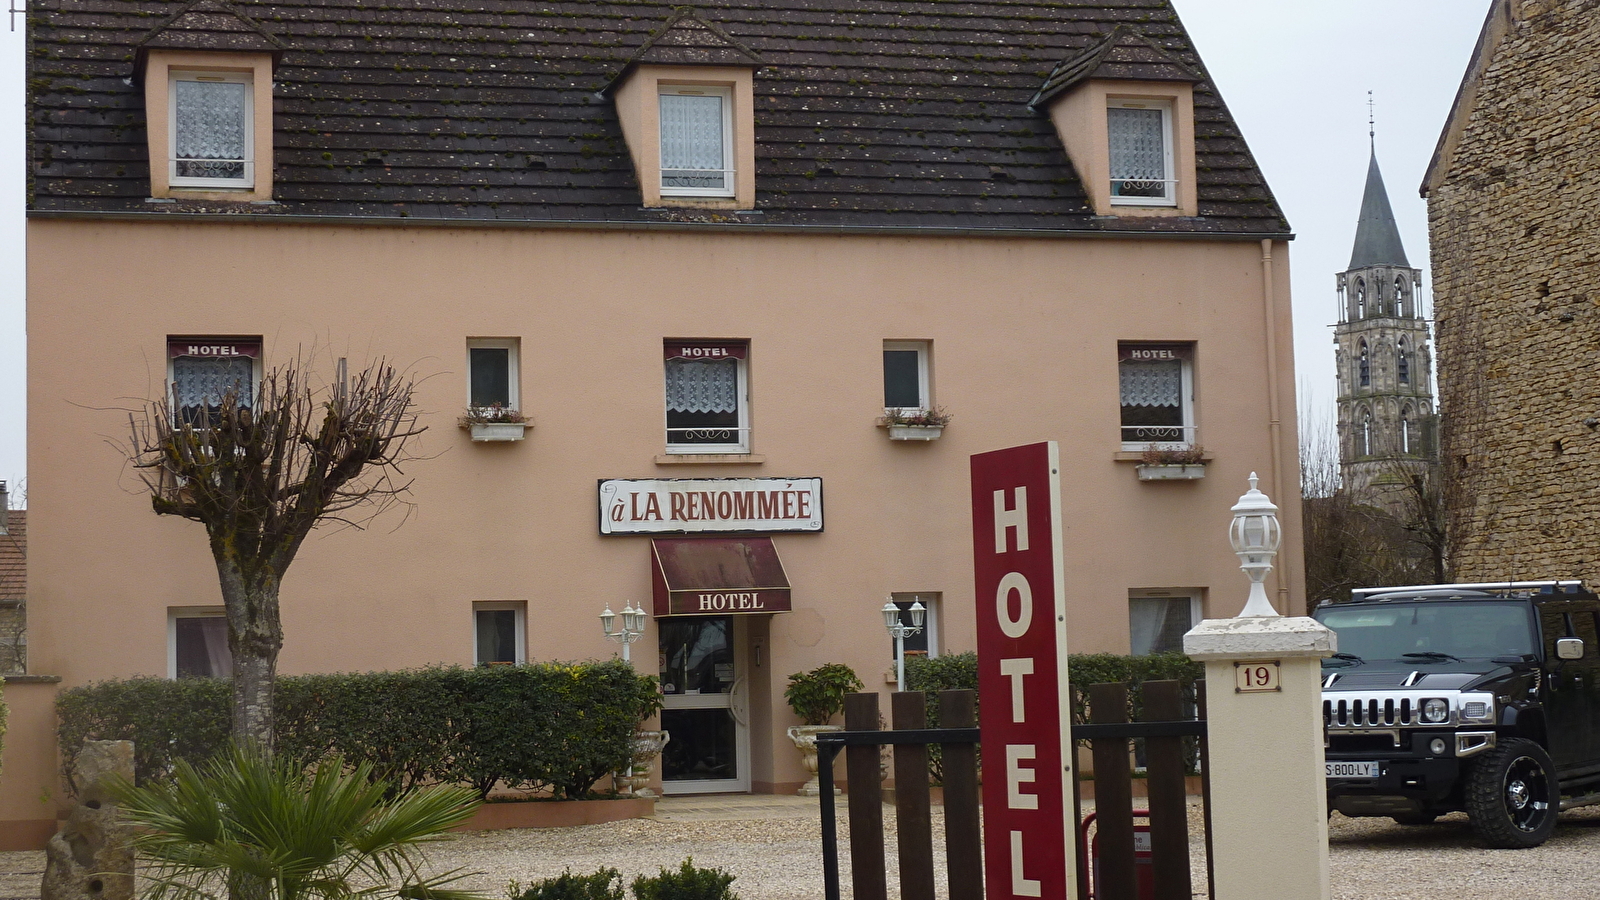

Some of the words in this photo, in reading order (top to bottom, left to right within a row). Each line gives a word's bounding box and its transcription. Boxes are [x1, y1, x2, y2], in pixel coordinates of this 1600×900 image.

[188, 345, 239, 355] HOTEL
[682, 347, 728, 356] HOTEL
[1131, 349, 1175, 358] HOTEL
[611, 498, 625, 522] à
[630, 492, 664, 521] LA
[669, 483, 812, 522] RENOMMÉE
[698, 592, 764, 611] HOTEL
[1244, 666, 1269, 686] 19
[993, 486, 1041, 898] HOTEL
[1326, 764, 1370, 776] S-800-LY
